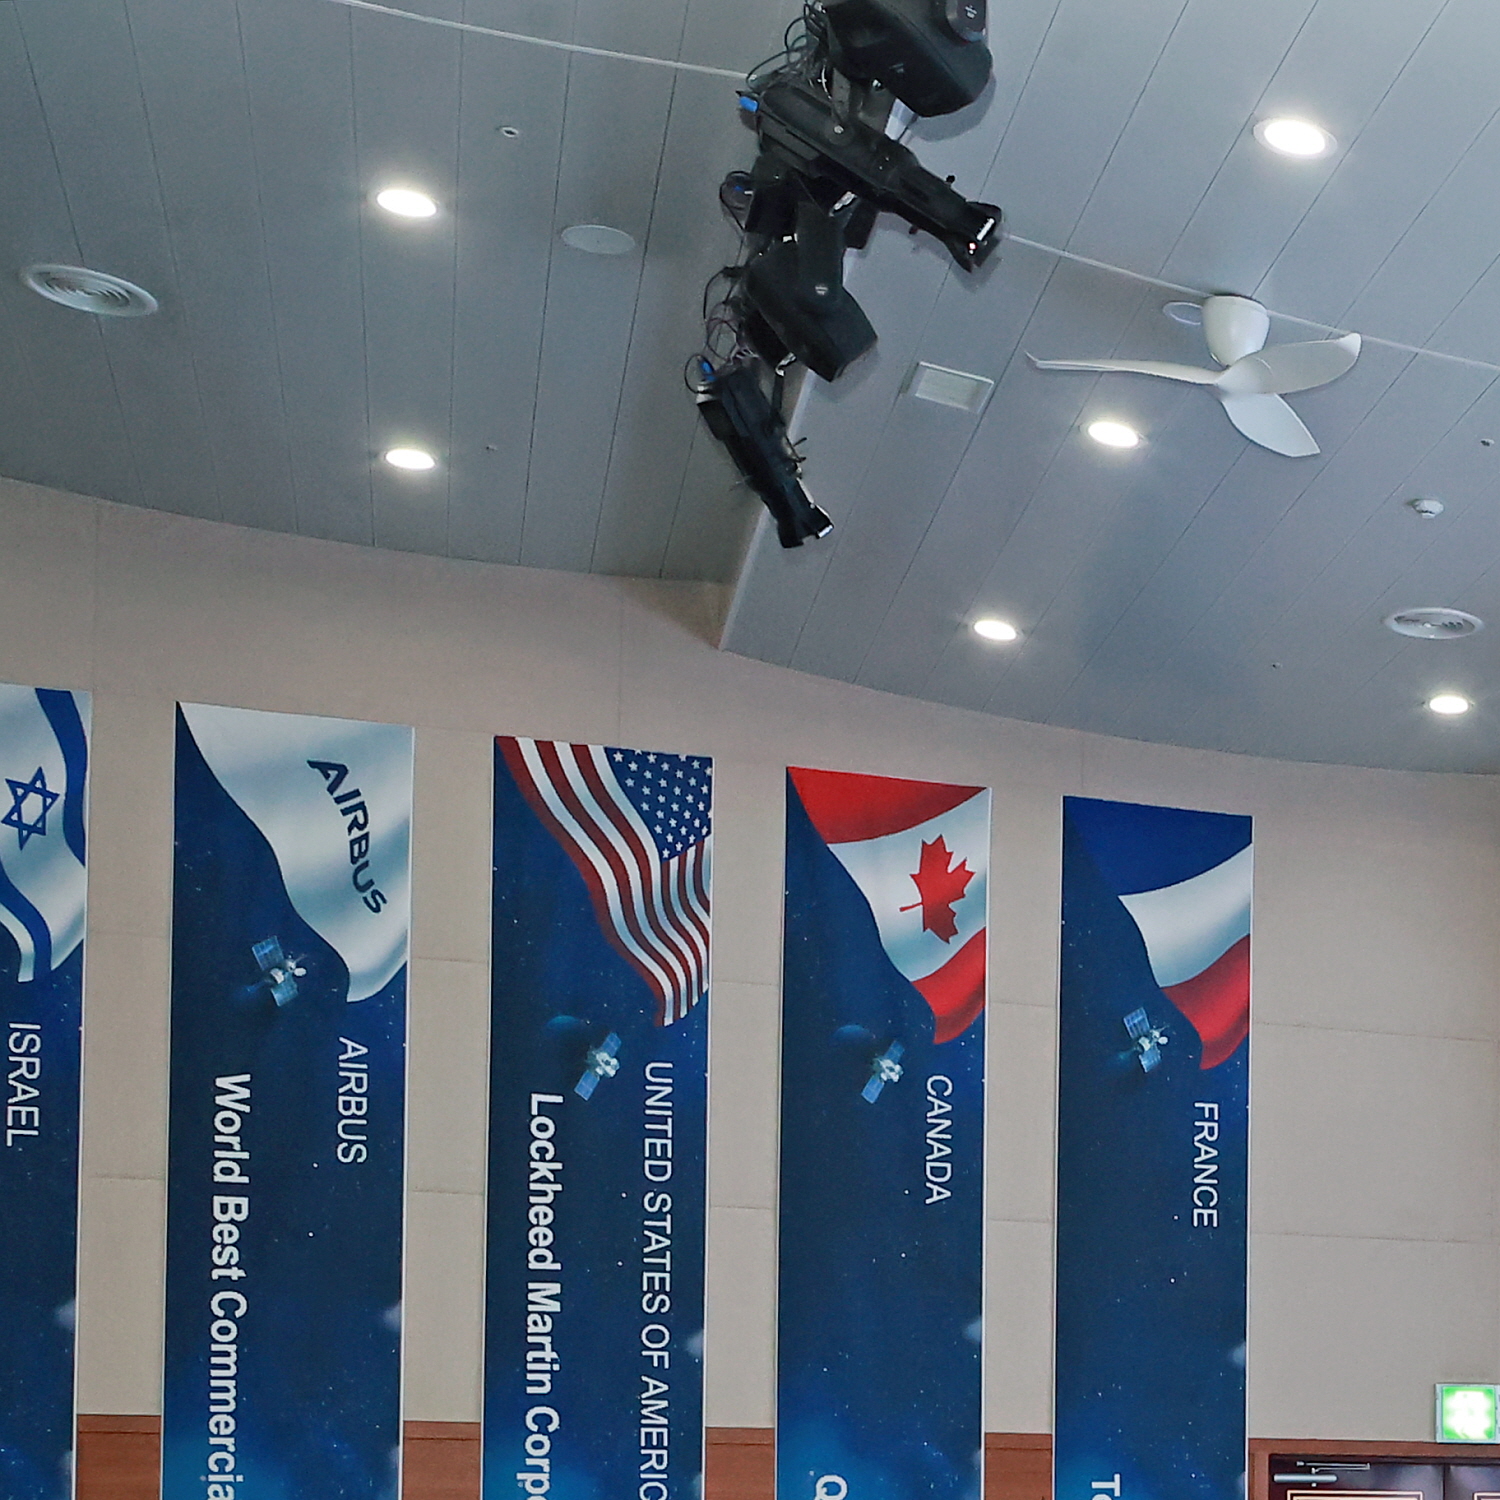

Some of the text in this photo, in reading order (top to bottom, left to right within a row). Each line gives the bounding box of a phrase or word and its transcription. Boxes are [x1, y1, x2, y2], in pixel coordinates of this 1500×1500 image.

[307, 758, 387, 914] AIRBUS
[6, 1021, 42, 1147] ISRAEL
[213, 1073, 251, 1185] World
[336, 1036, 368, 1164] AIRBUS
[642, 1061, 673, 1183] UNITED
[925, 1074, 953, 1205] CANADA
[526, 1092, 564, 1271] Lockheed
[1193, 1102, 1220, 1229] FRANCE
[210, 1196, 249, 1280] Best
[641, 1192, 672, 1315] STATES
[524, 1280, 562, 1395] Martin
[640, 1324, 670, 1369] OF
